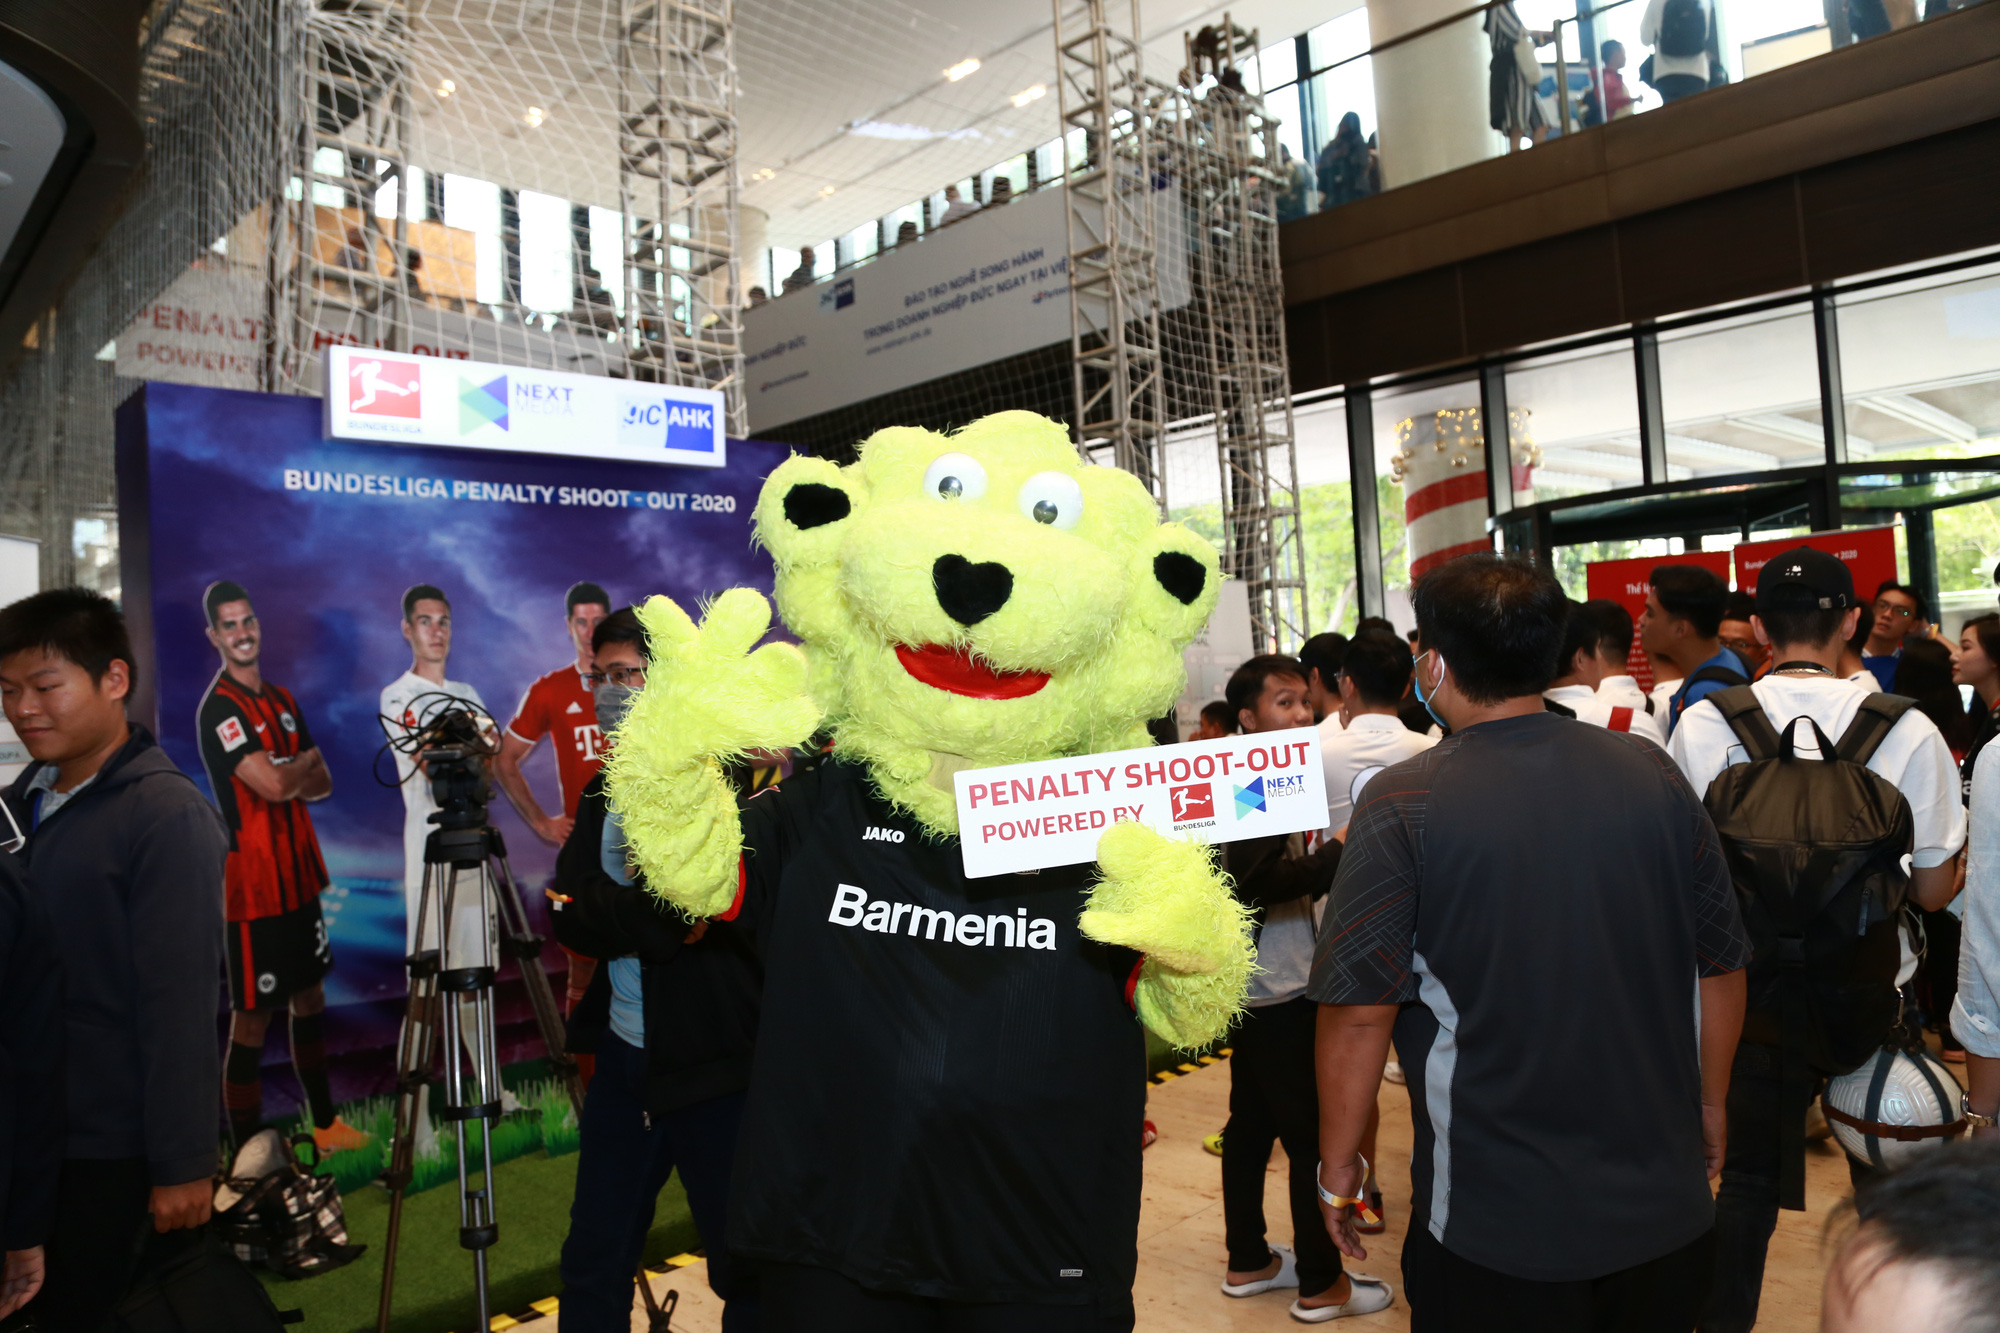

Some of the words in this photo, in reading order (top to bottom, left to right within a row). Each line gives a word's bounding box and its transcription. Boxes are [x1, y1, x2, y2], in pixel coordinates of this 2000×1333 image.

[1050, 255, 1069, 275] VIỆ
[515, 382, 574, 402] NEXT
[515, 400, 575, 417] MEDIA
[668, 405, 713, 430] AHK
[284, 469, 448, 498] BUNDESLIGA
[452, 480, 554, 505] PENALTY
[558, 486, 630, 507] SHOOT
[646, 491, 688, 510] OUT
[690, 493, 737, 513] 2020
[968, 766, 1116, 809] PENALTY
[1124, 742, 1310, 789] SHOOT-OUT
[1267, 774, 1304, 789] NEXT
[1267, 785, 1306, 798] MEDIA
[982, 809, 1106, 844] POWERED
[1112, 804, 1145, 827] BY
[862, 826, 905, 844] JAKO
[828, 883, 1057, 951] Barmenia
